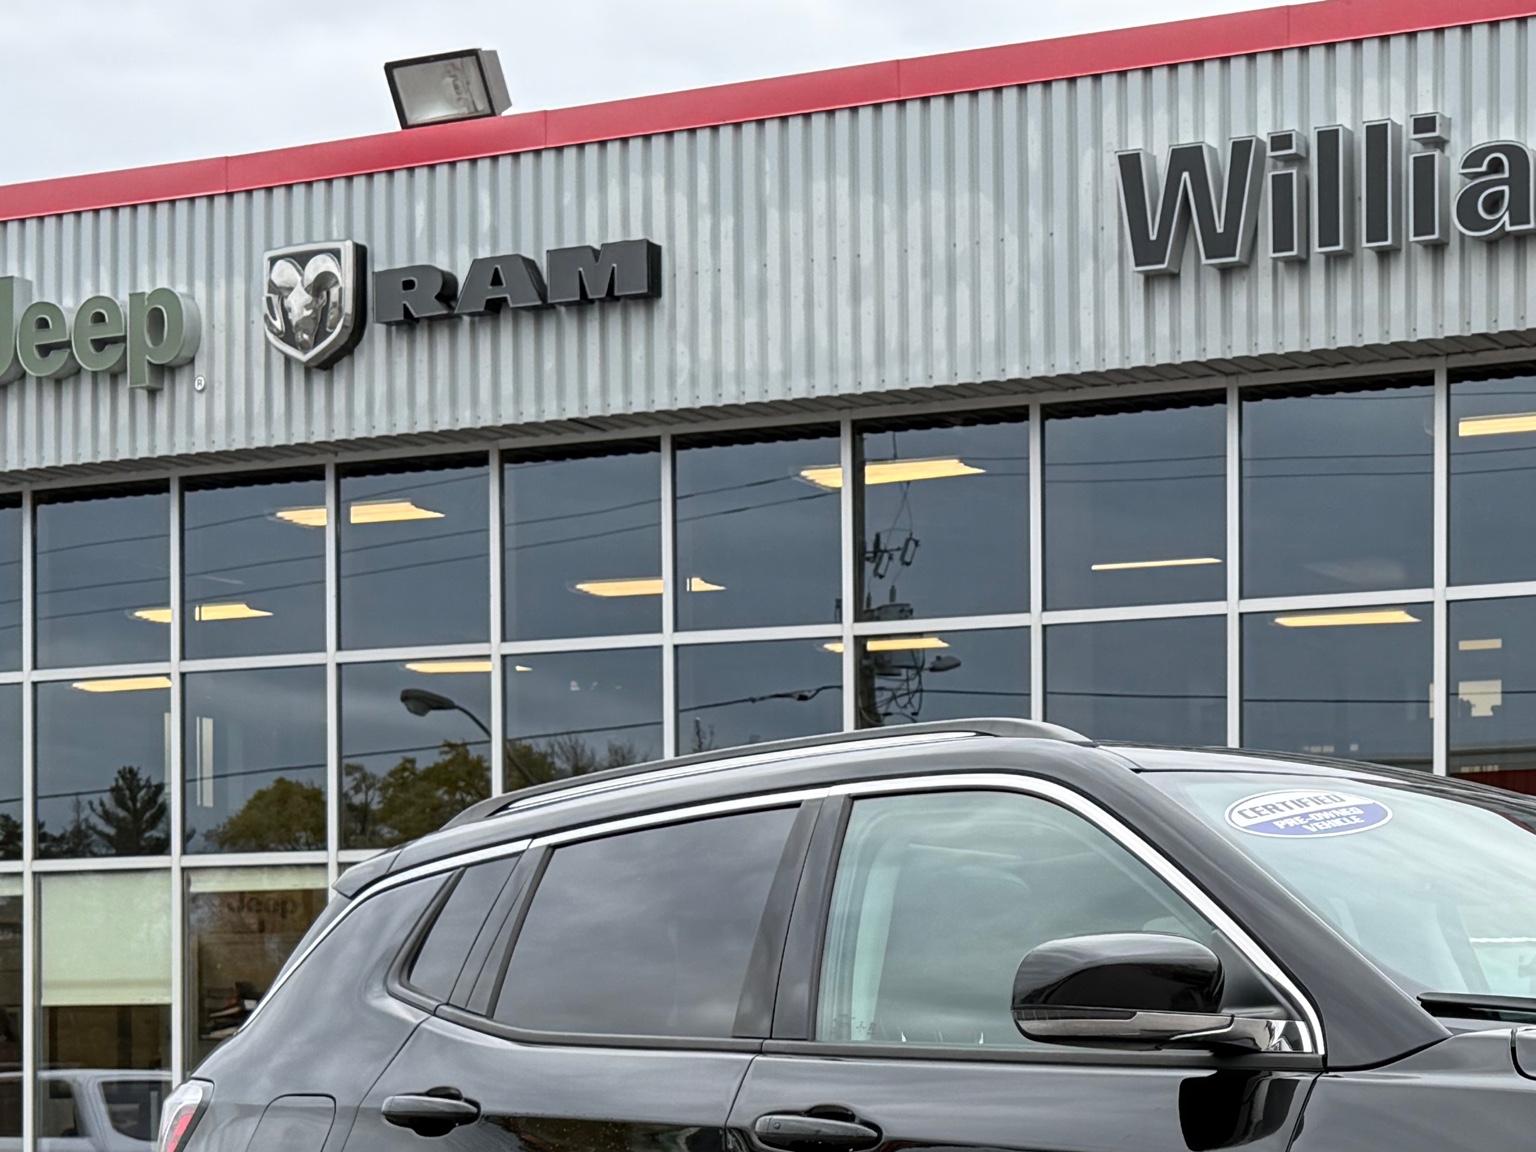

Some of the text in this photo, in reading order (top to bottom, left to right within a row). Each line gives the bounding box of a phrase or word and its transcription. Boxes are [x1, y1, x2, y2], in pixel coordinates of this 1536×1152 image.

[372, 238, 660, 324] RAM
[1237, 794, 1346, 820] CERTIFIED
[1272, 806, 1364, 829] PRE-OWNED
[1302, 815, 1365, 832] VEHICLE
